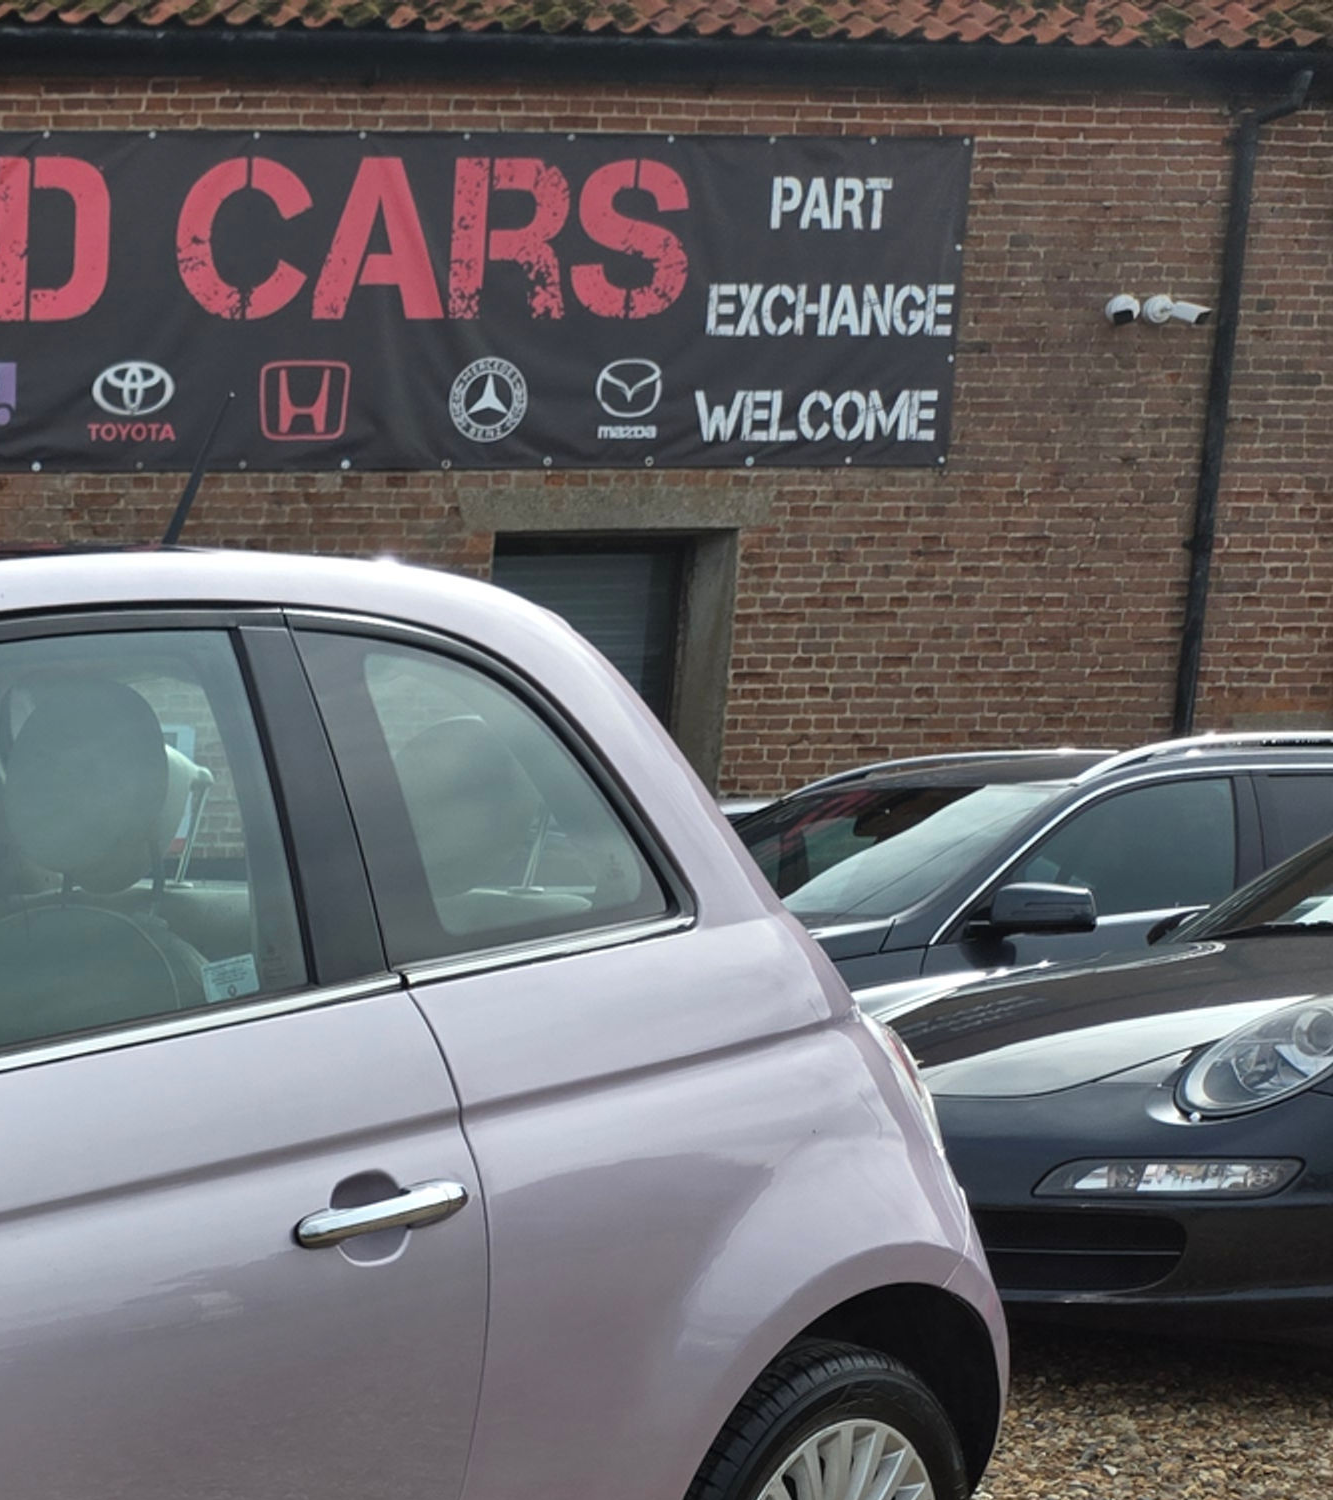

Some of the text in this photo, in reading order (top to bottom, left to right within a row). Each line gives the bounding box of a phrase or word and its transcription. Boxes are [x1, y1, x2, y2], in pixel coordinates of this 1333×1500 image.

[770, 175, 893, 231] PART
[176, 156, 690, 319] CARS
[706, 283, 956, 337] EXCHANGE
[87, 422, 177, 442] TOYOTA
[694, 389, 939, 442] WELCOME
